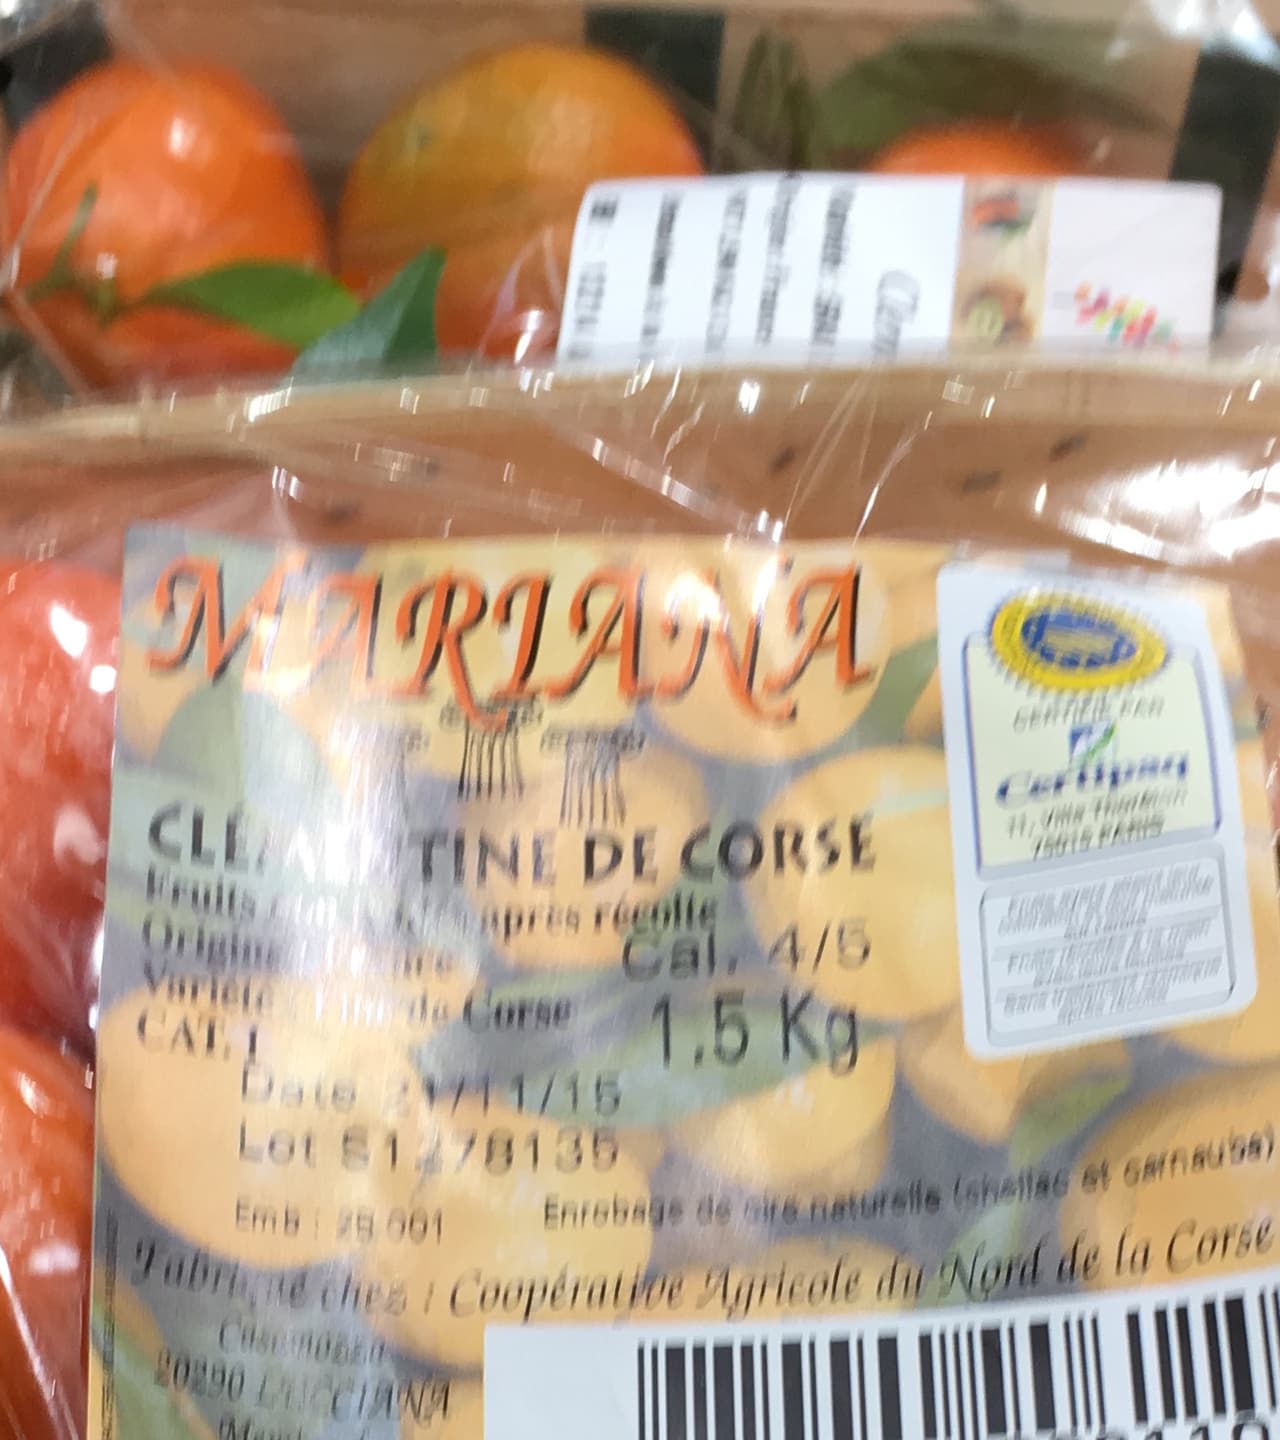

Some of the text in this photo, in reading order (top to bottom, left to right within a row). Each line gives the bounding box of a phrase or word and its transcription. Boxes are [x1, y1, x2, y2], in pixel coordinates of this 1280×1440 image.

[150, 553, 875, 731] MARIANA
[584, 828, 658, 888] DE
[680, 811, 876, 882] CORSE
[621, 916, 873, 983] Cal. 4/5
[651, 984, 860, 1079] 1.5 Kg
[240, 1060, 357, 1113] Date
[238, 1114, 317, 1169] Lot
[234, 1197, 302, 1239] Emb
[543, 1192, 684, 1230] Enrobage
[696, 1192, 732, 1227] de
[809, 1177, 942, 1224] naturelle
[1080, 1158, 1112, 1194] et
[449, 1262, 686, 1328] Coopérative
[695, 1252, 862, 1324] Agricole
[875, 1254, 924, 1306] du
[937, 1229, 1051, 1302] Nord
[1055, 1225, 1101, 1286] de
[1115, 1221, 1154, 1278] la
[1166, 1214, 1277, 1276] Corse
